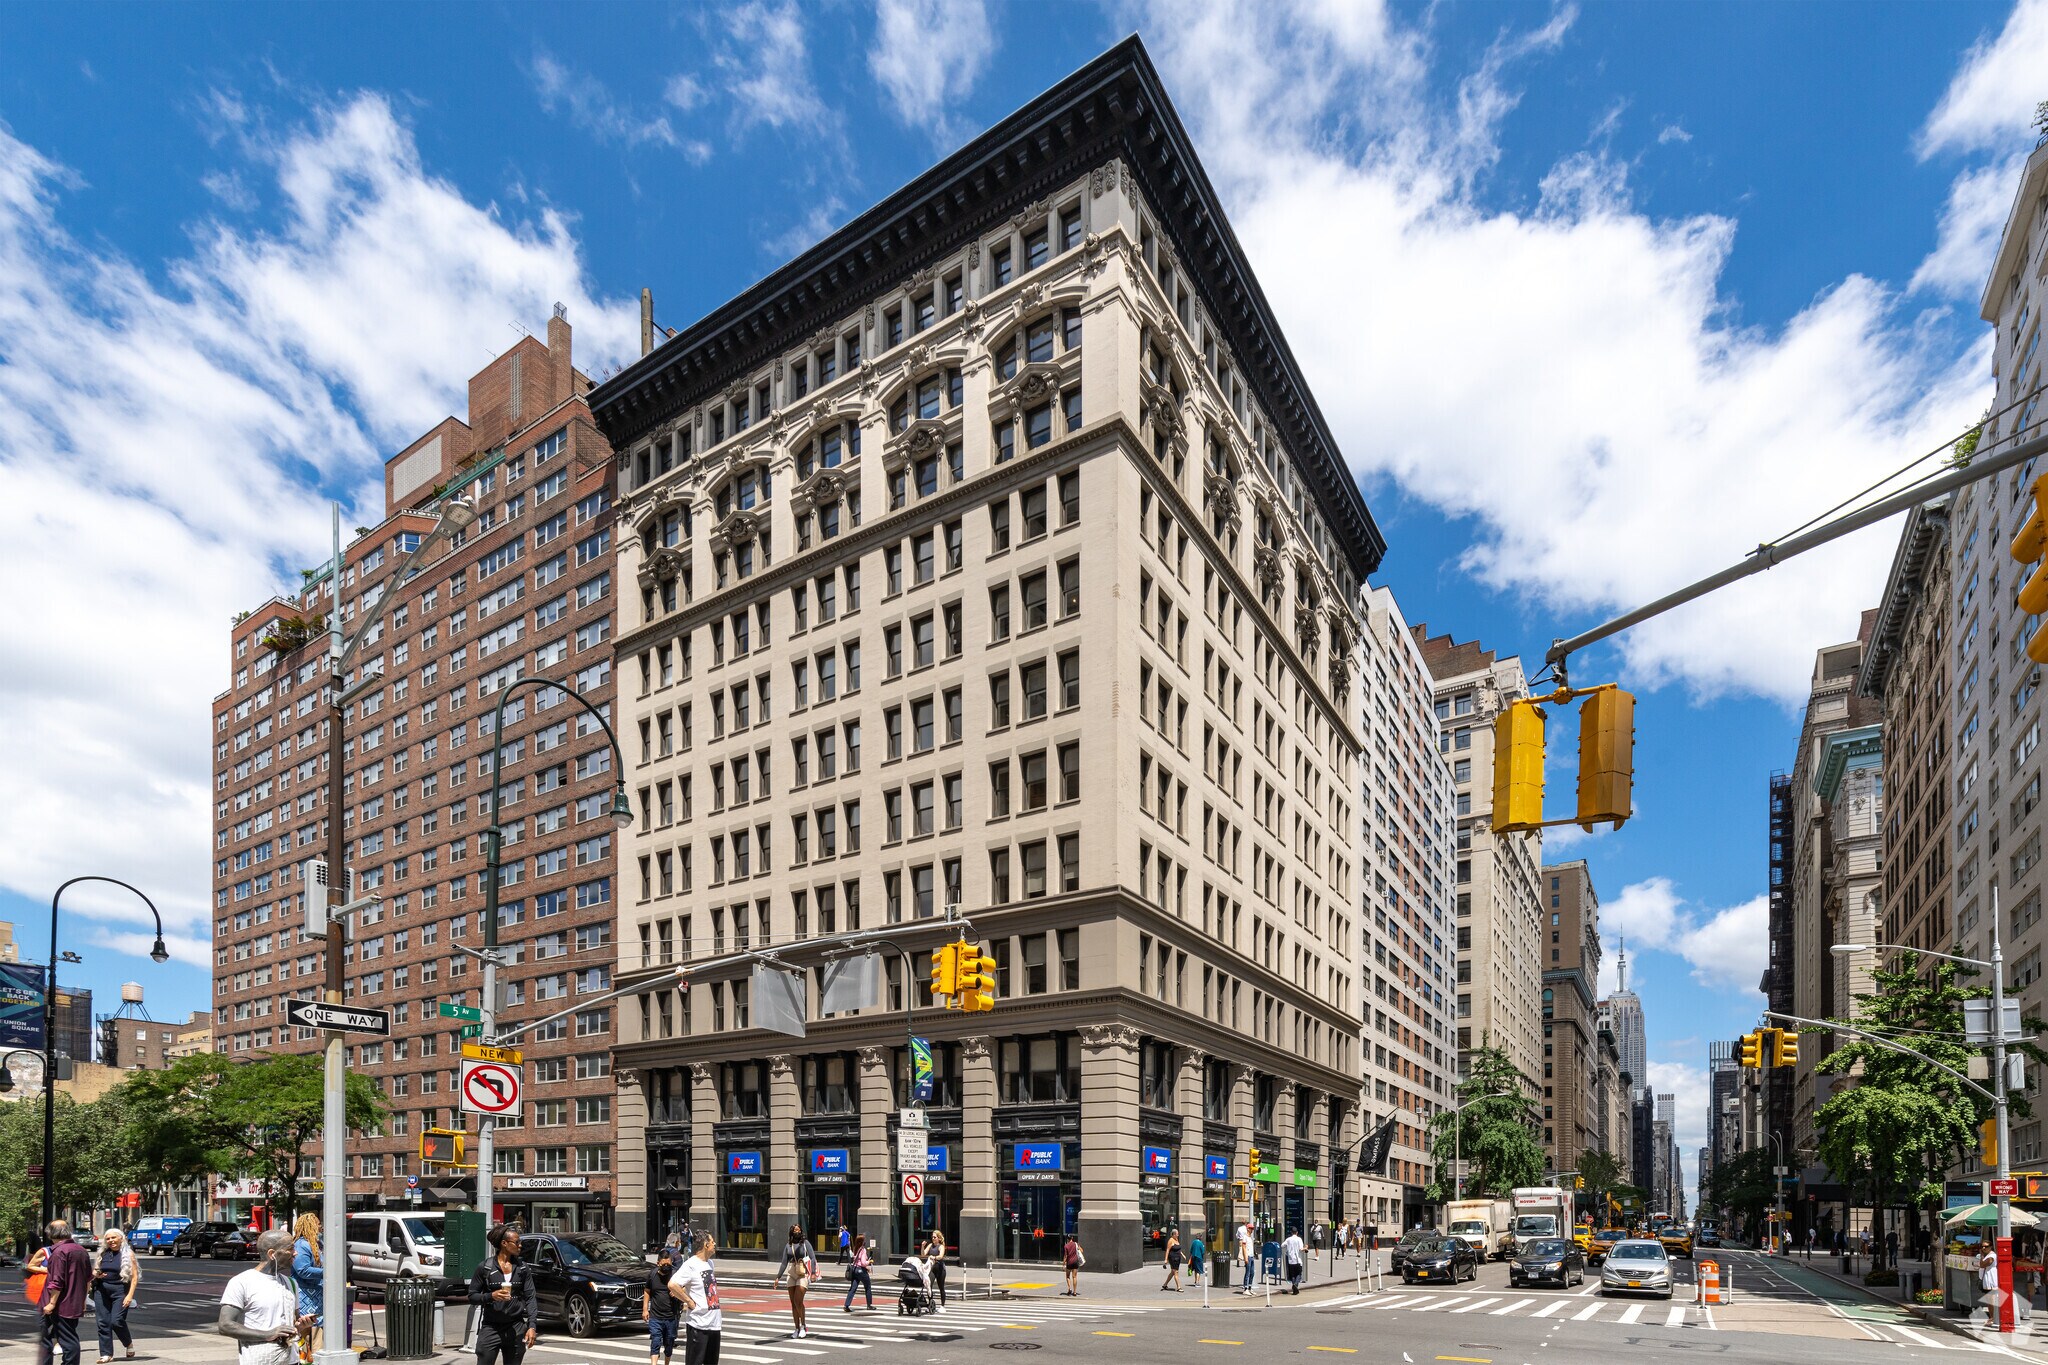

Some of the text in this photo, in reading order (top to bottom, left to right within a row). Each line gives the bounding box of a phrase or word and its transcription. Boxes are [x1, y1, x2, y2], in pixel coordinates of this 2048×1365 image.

[6, 993, 30, 1001] BACK
[452, 1006, 459, 1017] 5
[304, 1009, 377, 1027] ONE WAY
[11, 1025, 40, 1033] SQUARE
[464, 1026, 470, 1036] W
[480, 1048, 505, 1060] NEW
[1020, 1149, 1053, 1165] REPUBLIC
[1369, 1137, 1381, 1168] COMPASS
[528, 1179, 559, 1187] Goodwill
